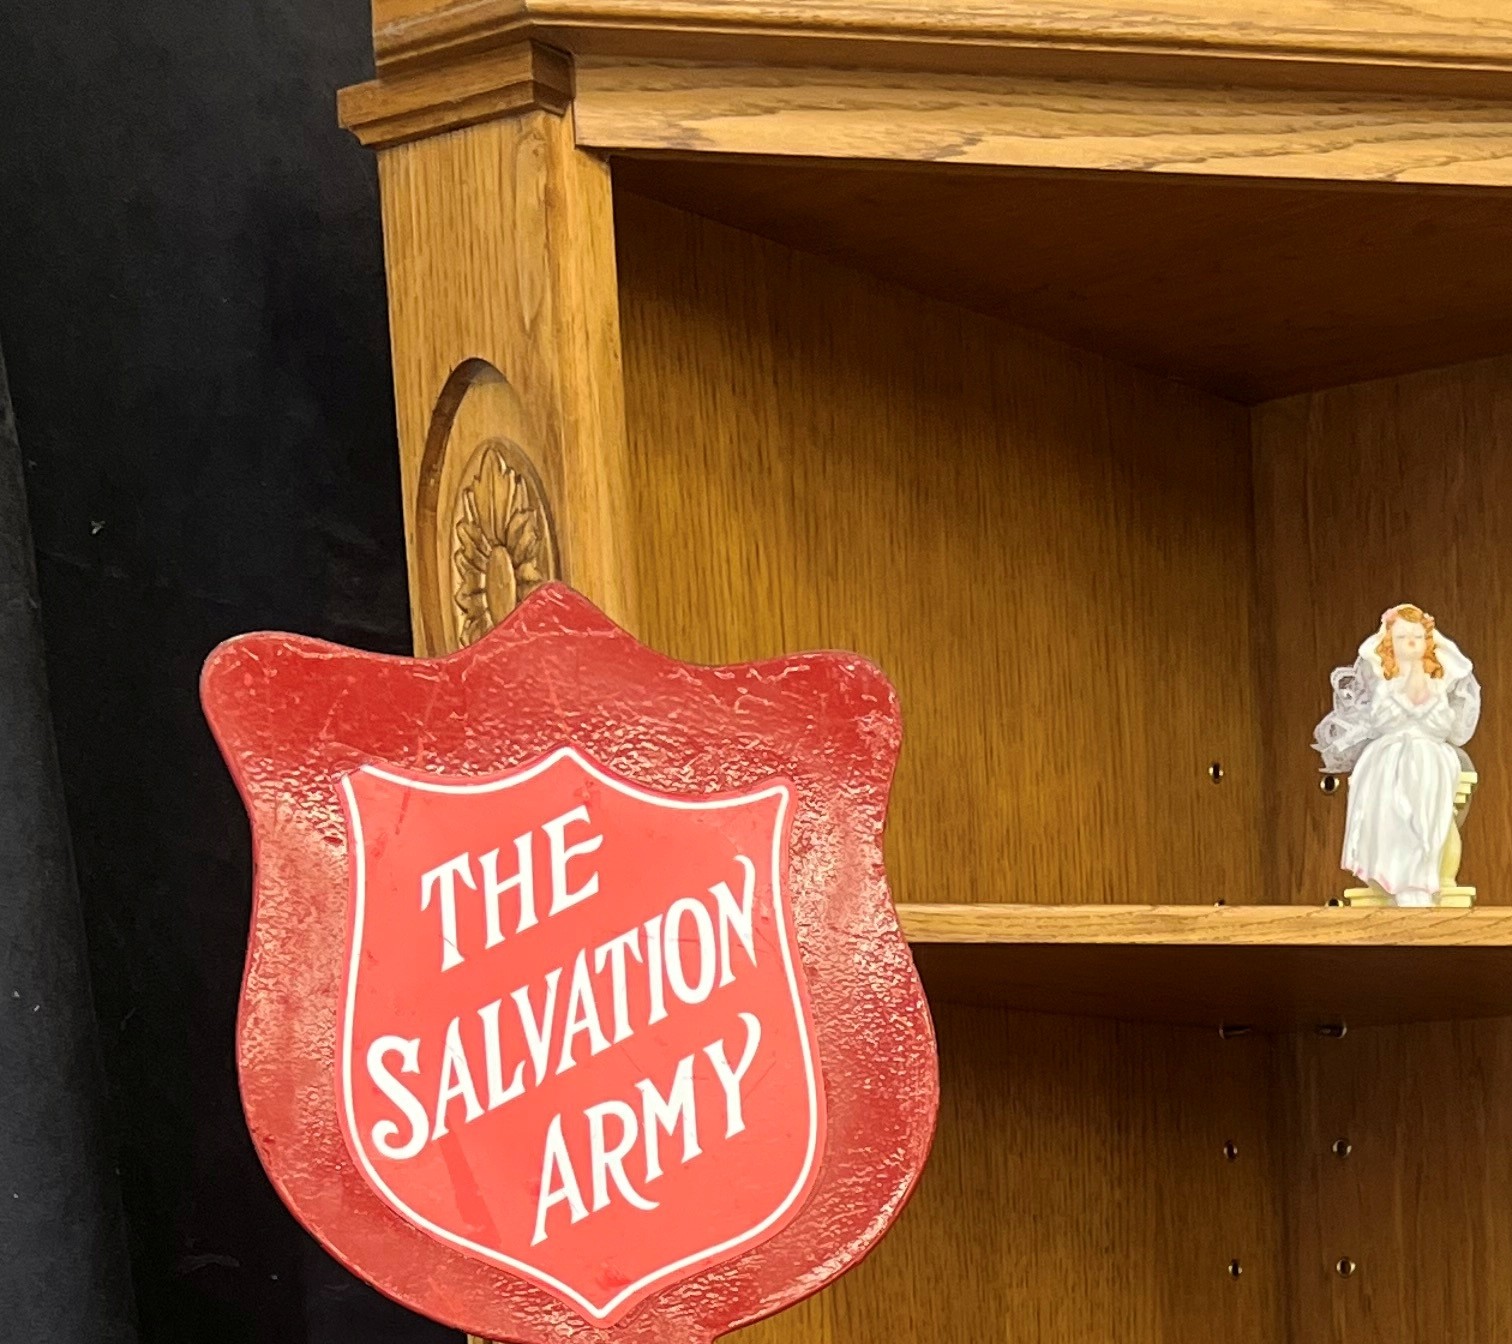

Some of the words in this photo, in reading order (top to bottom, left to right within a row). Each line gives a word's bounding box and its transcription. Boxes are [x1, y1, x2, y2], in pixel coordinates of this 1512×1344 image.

[420, 806, 603, 972] THE
[366, 855, 758, 1160] SALVATION
[531, 1013, 761, 1246] ARMY
